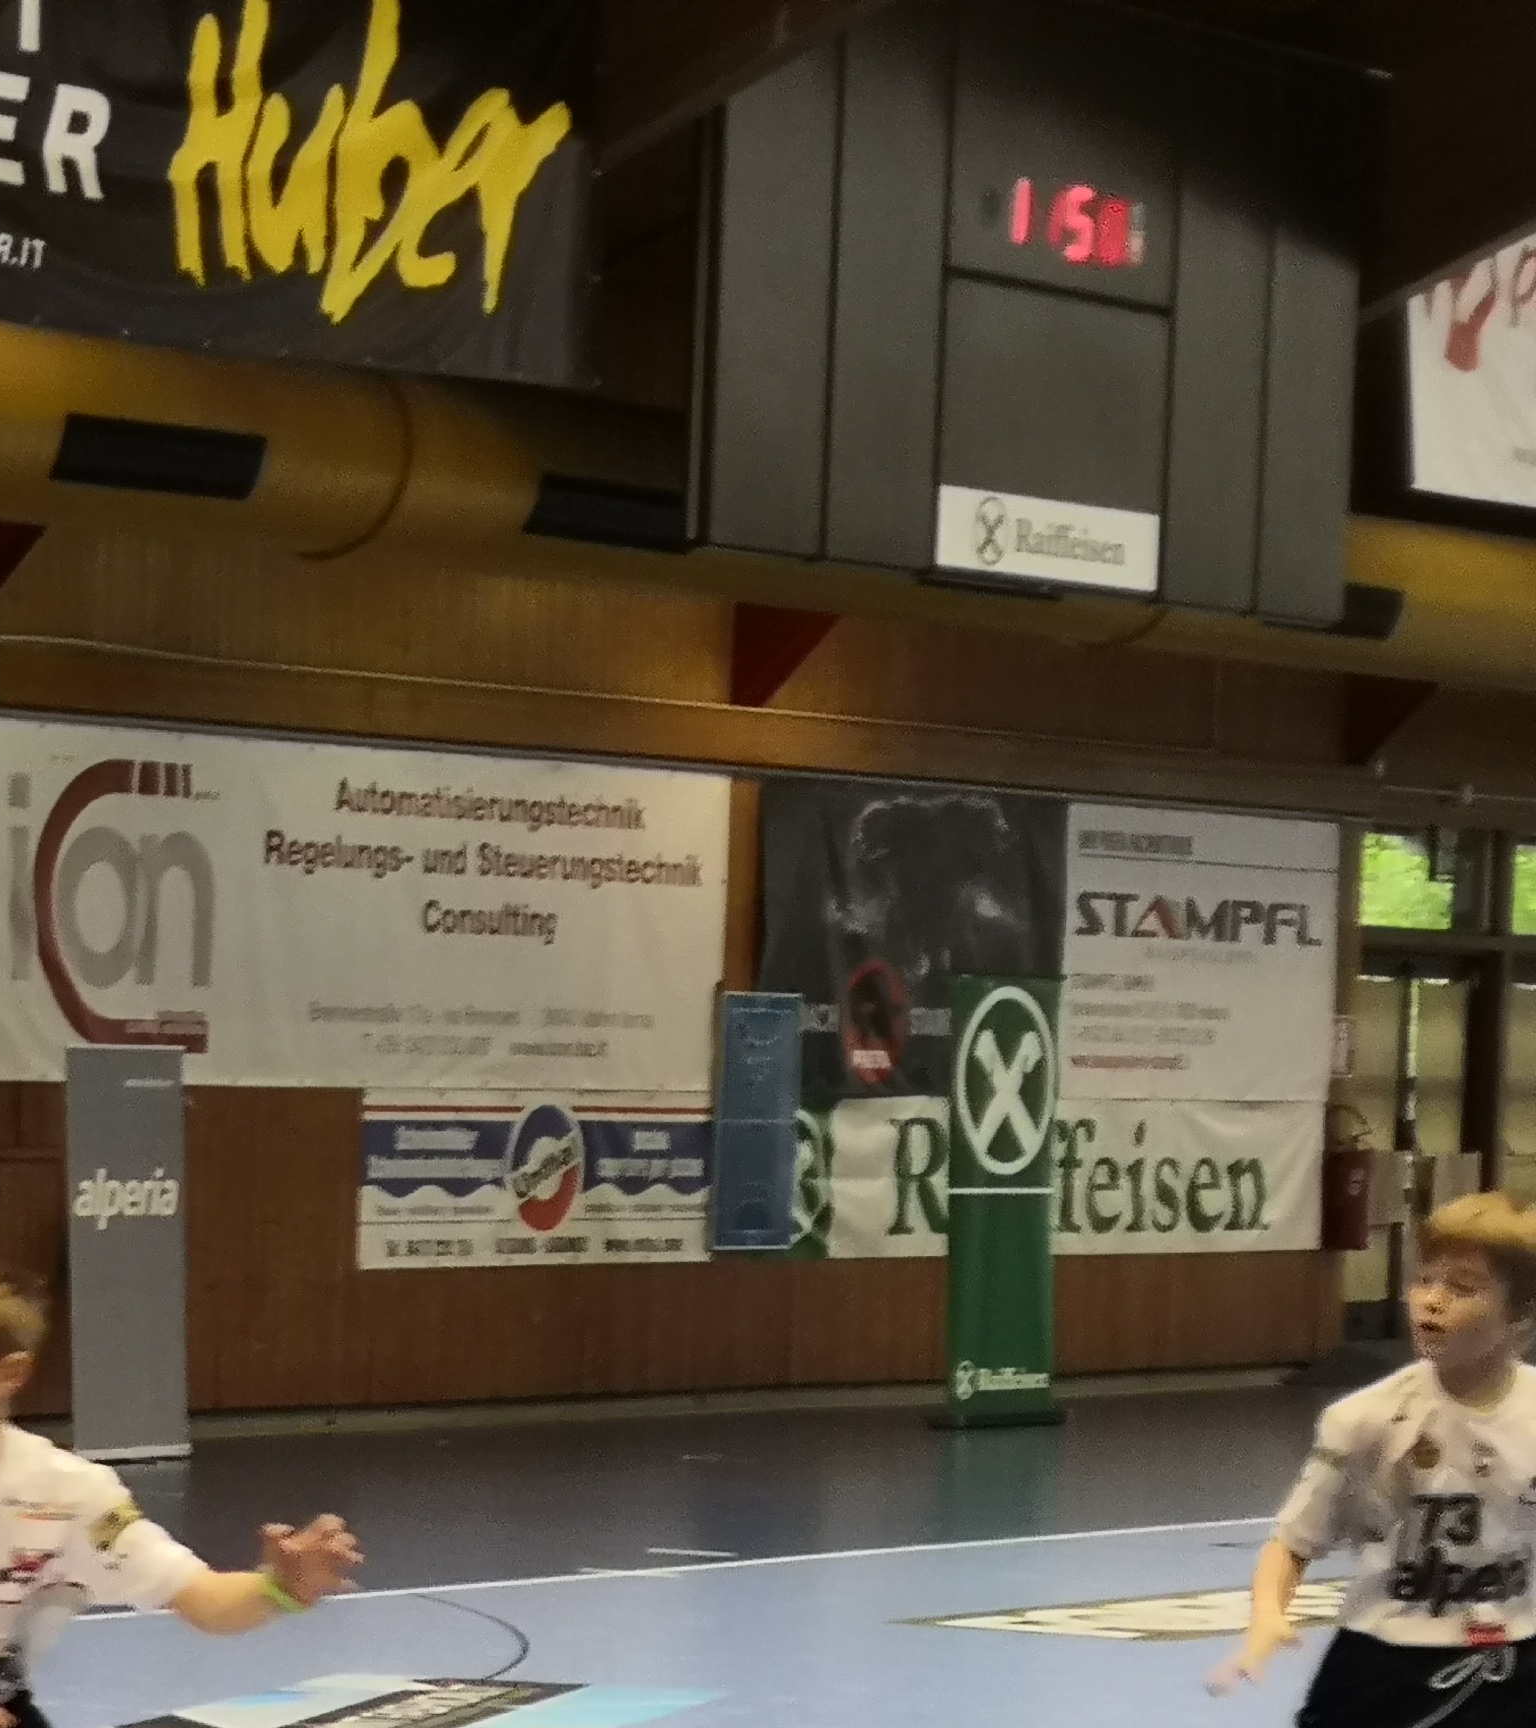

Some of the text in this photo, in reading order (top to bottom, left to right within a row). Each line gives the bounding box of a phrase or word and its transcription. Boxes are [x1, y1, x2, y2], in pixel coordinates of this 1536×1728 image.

[171, 0, 571, 323] Huber
[423, 899, 560, 945] Consulting
[883, 1115, 1279, 1236] Rfeisen
